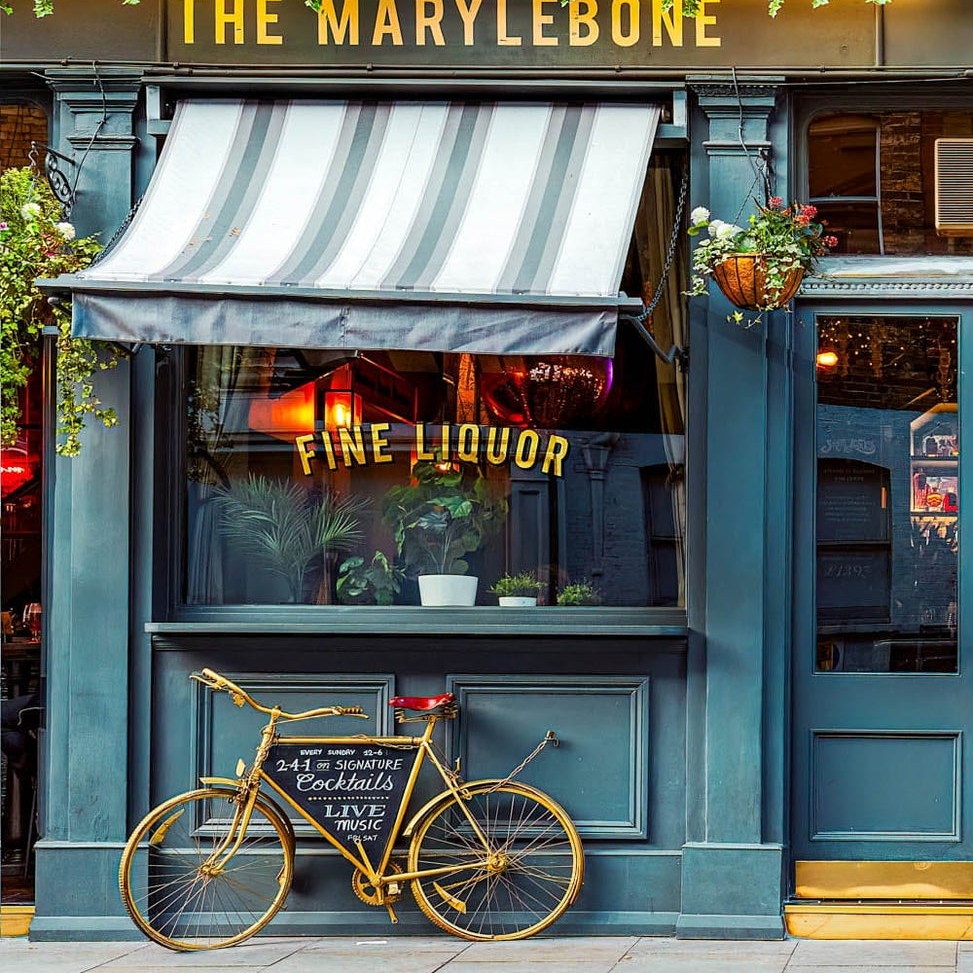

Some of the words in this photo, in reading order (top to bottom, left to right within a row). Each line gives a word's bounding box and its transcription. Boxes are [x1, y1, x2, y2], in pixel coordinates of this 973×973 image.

[295, 423, 394, 476] FINE
[415, 421, 569, 477] LIQUOR
[300, 748, 323, 756] EVERY
[327, 748, 356, 756] SUNDAY
[276, 758, 312, 772] 2-4-1
[316, 760, 331, 771] on
[334, 758, 404, 771] SIGNATURE
[296, 771, 394, 792] Cocktails
[324, 804, 387, 818] LIVE
[334, 819, 384, 831] MUSIC
